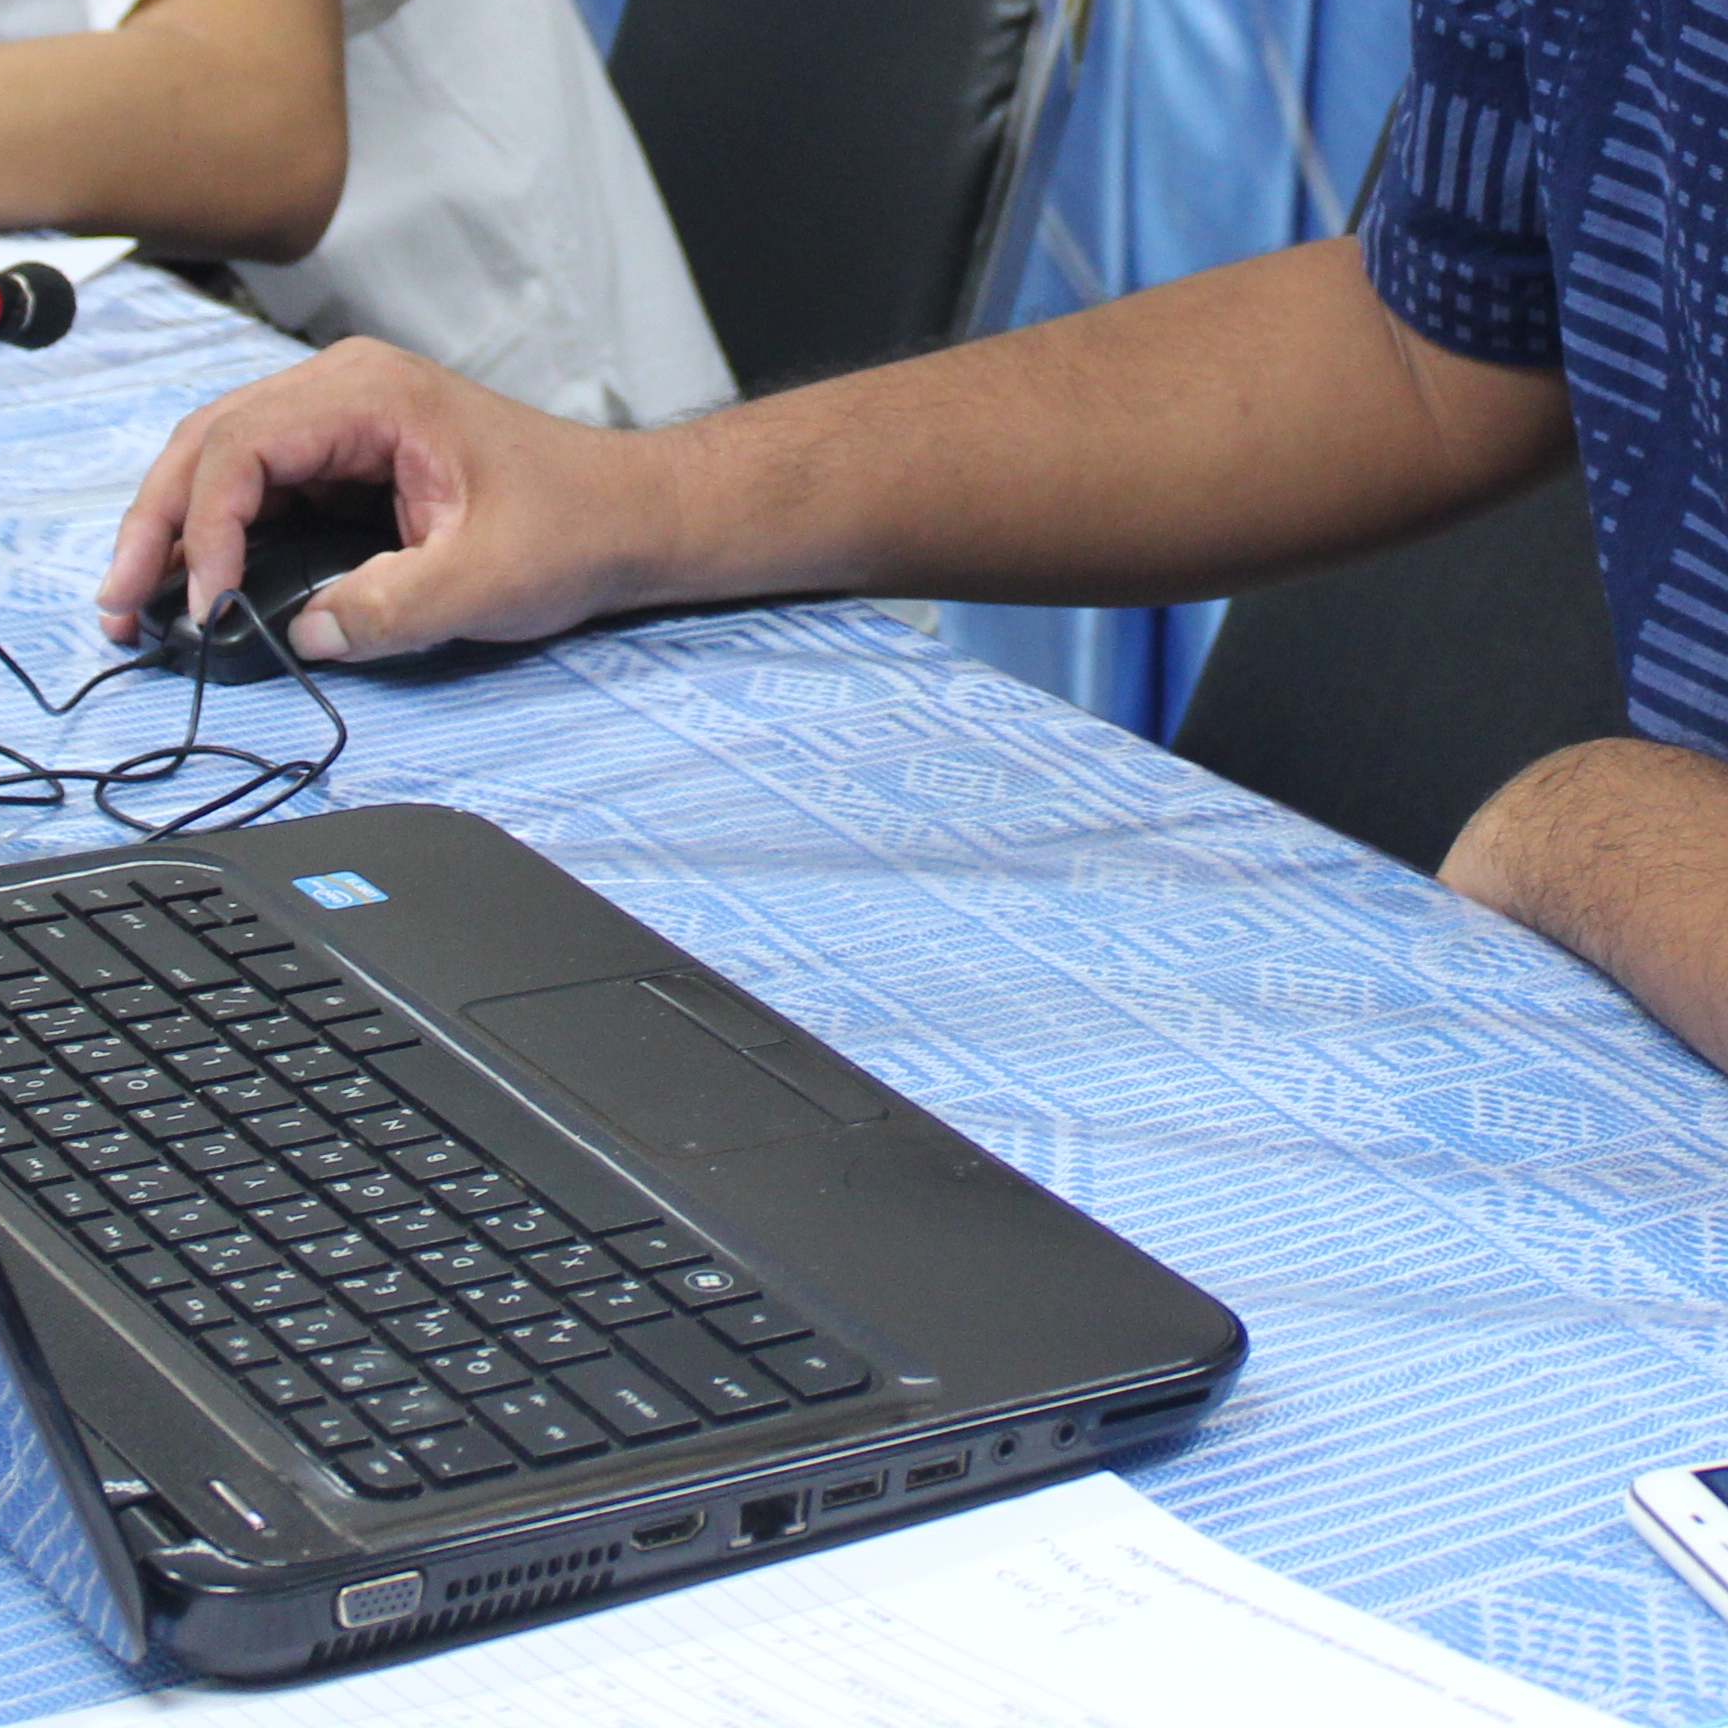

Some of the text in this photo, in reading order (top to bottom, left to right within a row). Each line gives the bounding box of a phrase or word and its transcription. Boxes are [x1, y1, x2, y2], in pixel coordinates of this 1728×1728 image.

[126, 1079, 149, 1090] O
[238, 1088, 262, 1099] K
[203, 1145, 227, 1155] U
[319, 1152, 343, 1164] H
[244, 1179, 266, 1189] Y
[340, 1086, 633, 1306] Z X C V B N M
[361, 1185, 385, 1197] G
[330, 1247, 353, 1258] R
[452, 1257, 475, 1268] D
[373, 1285, 397, 1295] E
[498, 1294, 521, 1304] S
[307, 1322, 329, 1332] 3
[415, 1322, 444, 1337] W
[548, 1332, 571, 1343] A
[353, 1361, 375, 1372] 2
[466, 1360, 492, 1374] Q
[400, 1402, 420, 1412] 1
